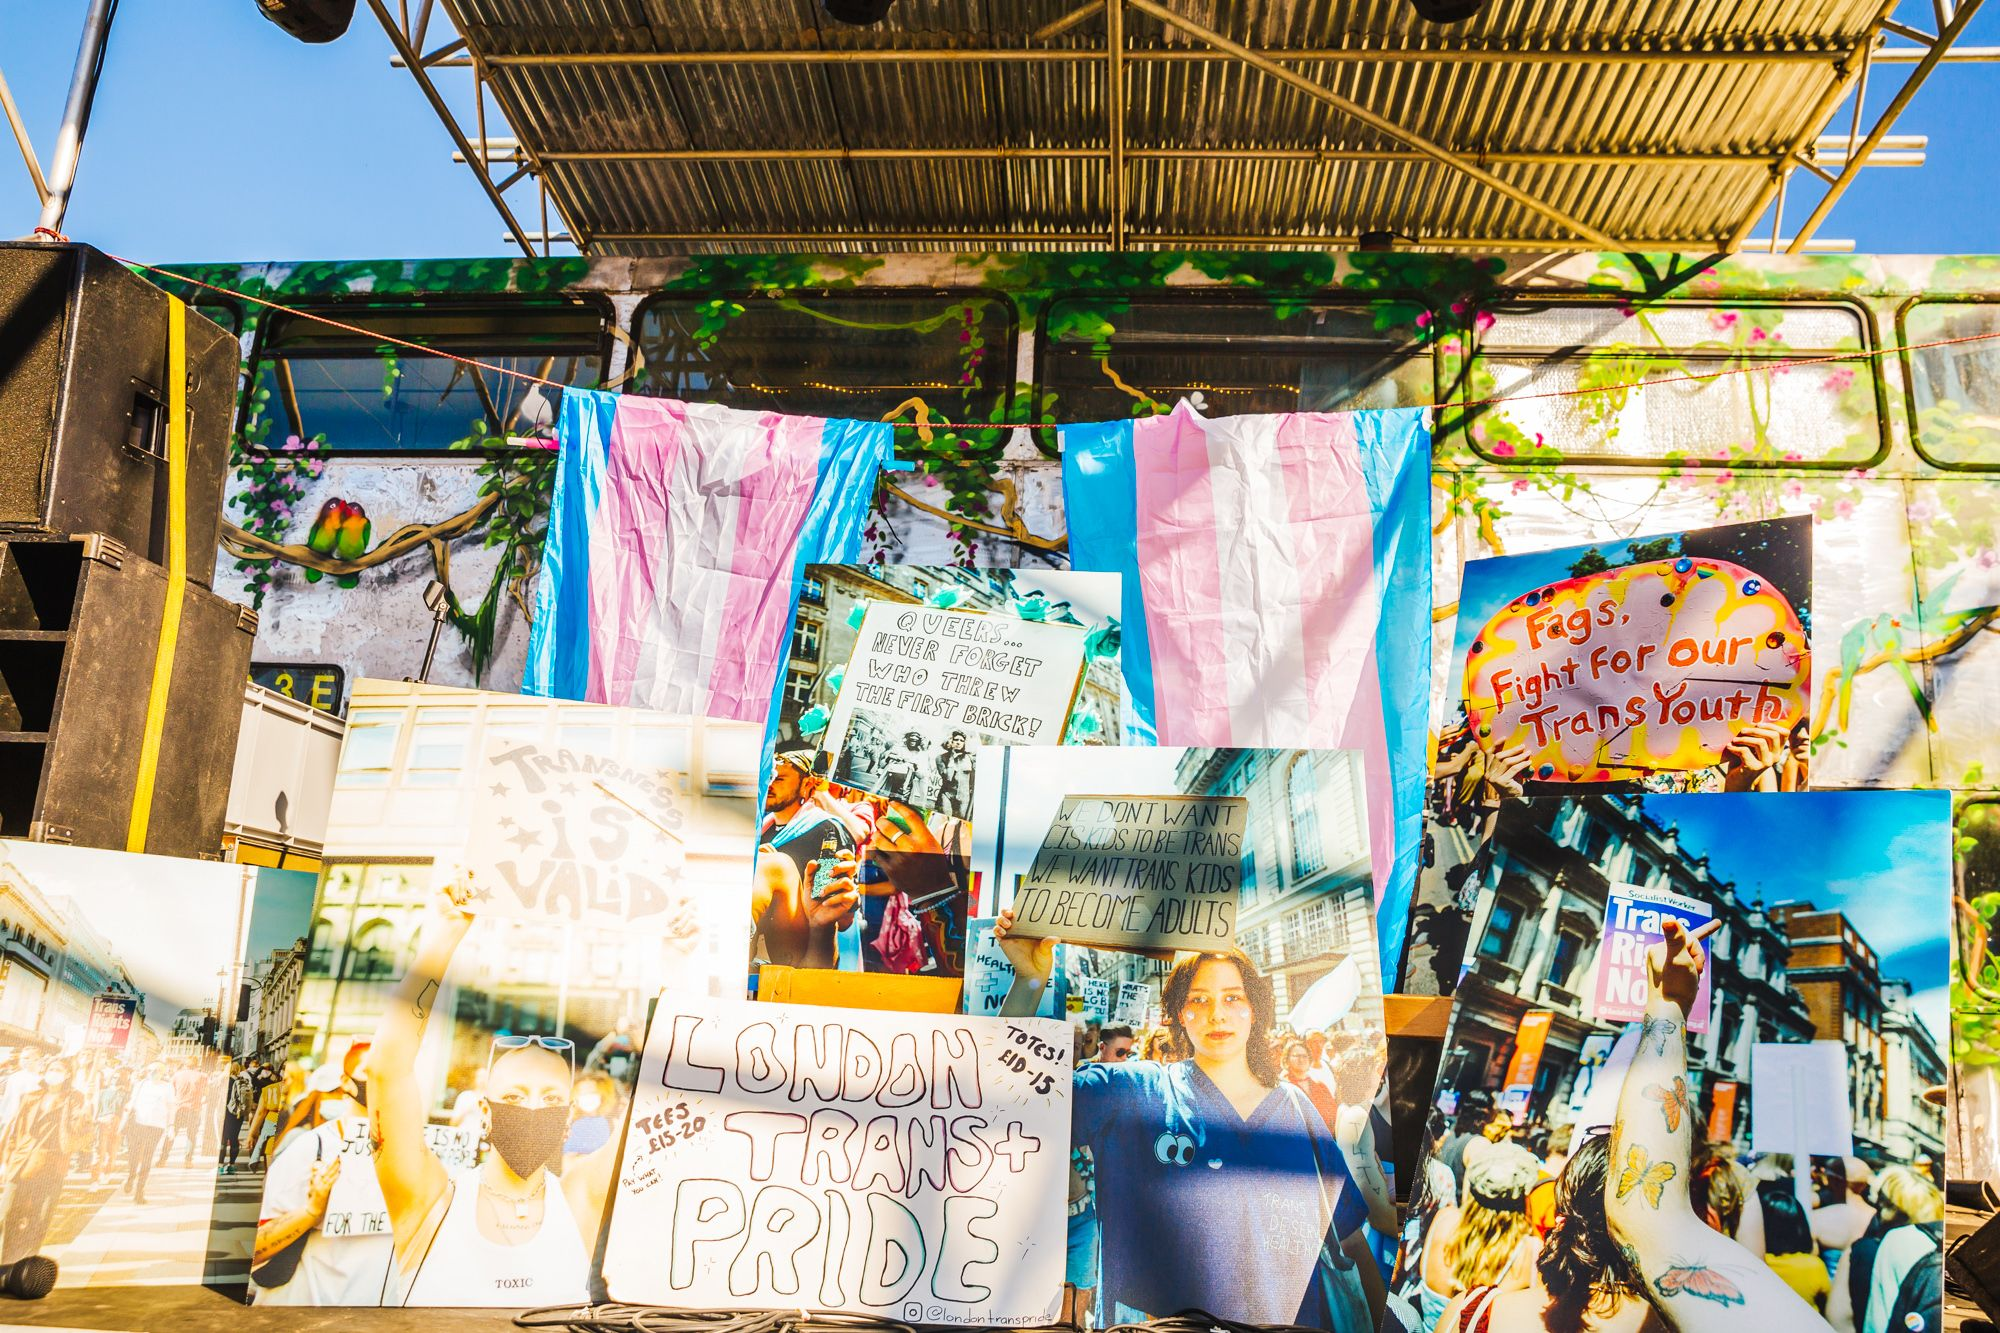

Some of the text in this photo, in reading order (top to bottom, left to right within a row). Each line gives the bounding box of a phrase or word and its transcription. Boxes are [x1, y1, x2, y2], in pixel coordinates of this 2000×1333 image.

[1526, 599, 1631, 650] Fags,
[872, 632, 1042, 678] NEVER FORGET
[868, 658, 1021, 704] WHO THREW
[1489, 657, 1580, 714] Fight
[855, 681, 1043, 739] THE FIRST BRICK!
[1519, 679, 1783, 747] Trans Youth
[1059, 800, 1089, 823] WE
[1163, 803, 1238, 826] WANT
[1042, 825, 1242, 857] CIS KIDS TO BE TRANS
[1031, 854, 1236, 894] WE WANT TRANS KIDS
[1017, 888, 1233, 938] TO BECOME ADULTS
[662, 1014, 983, 1109] LONDON
[1006, 1025, 1065, 1066] TOTES!
[635, 1102, 690, 1135] TEES
[648, 1116, 707, 1155] £15-20
[638, 1168, 657, 1181] WHAT
[723, 1107, 1042, 1199] TRANS+
[325, 1211, 387, 1235] FOR THE
[669, 1178, 999, 1308] PRIDE
[495, 1277, 534, 1289] TOXIC
